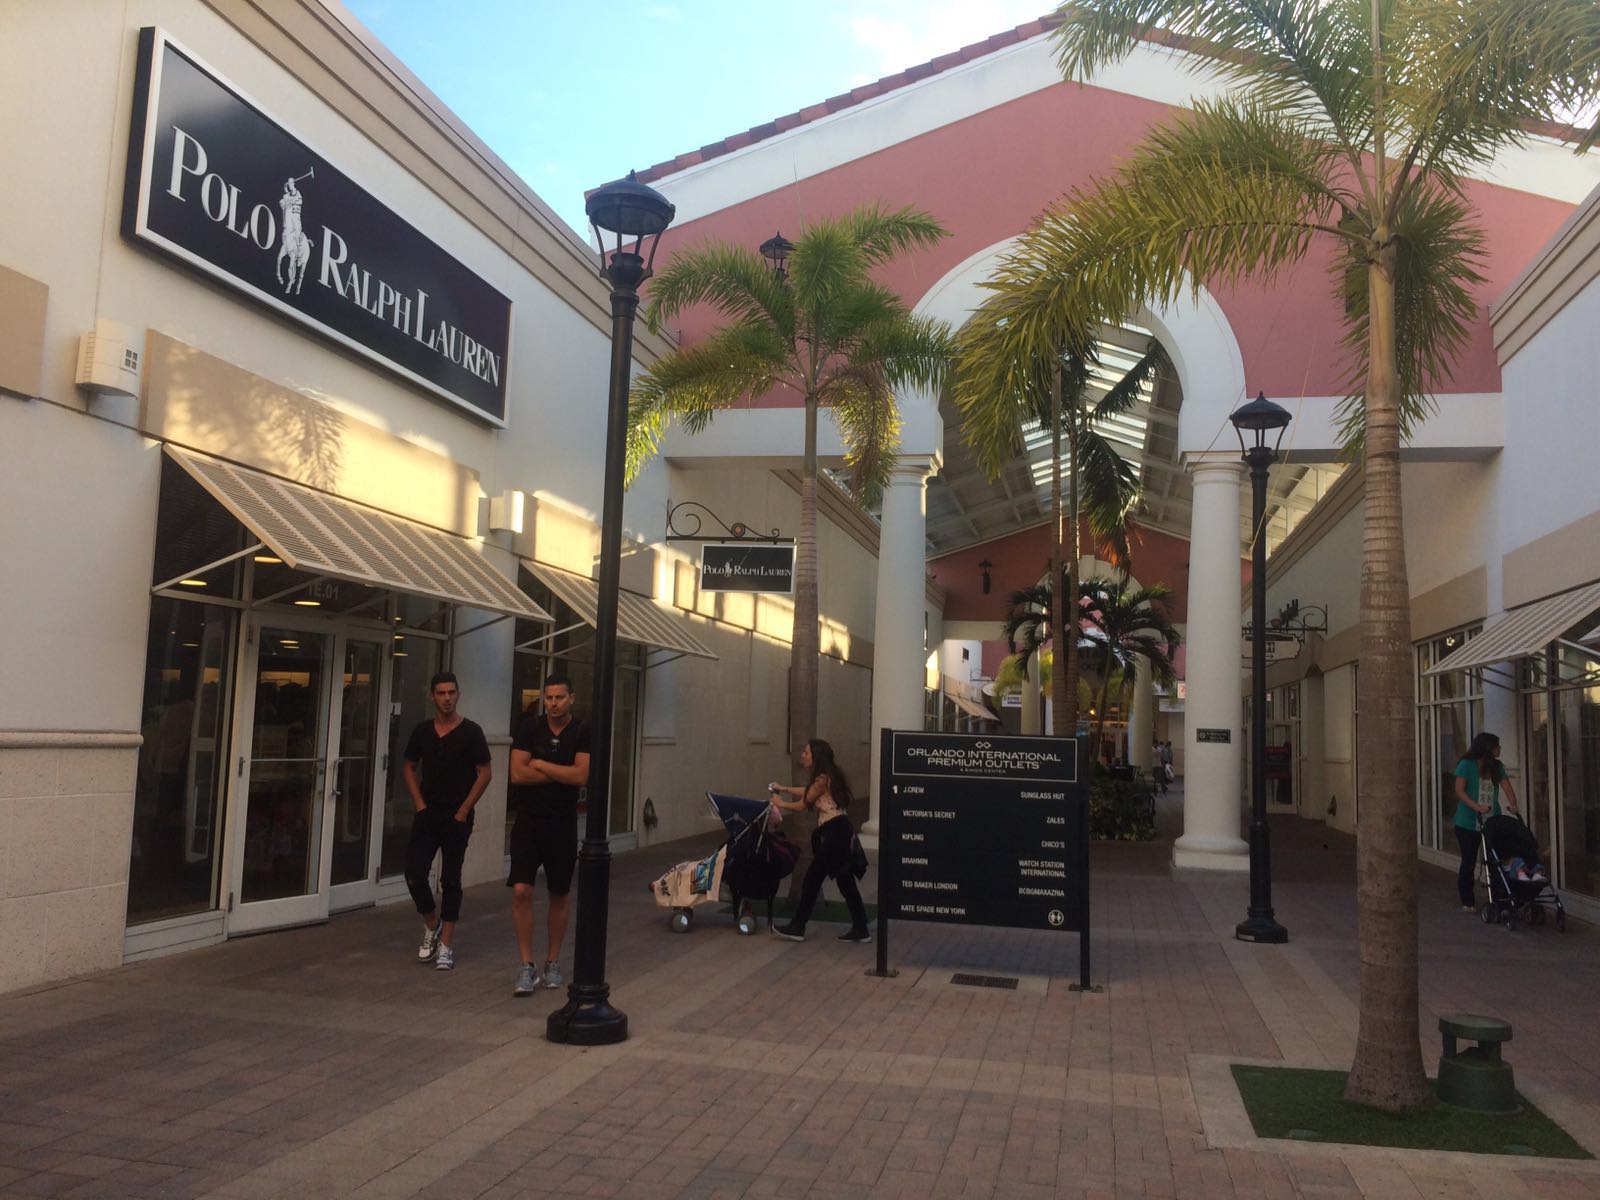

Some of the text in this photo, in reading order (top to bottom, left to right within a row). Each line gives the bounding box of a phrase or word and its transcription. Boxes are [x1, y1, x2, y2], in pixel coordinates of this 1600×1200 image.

[166, 125, 502, 388] POLO RALPH LAUREN
[703, 564, 792, 576] POLO RALPH LAUREN
[907, 747, 1061, 762] ORLANDO INTERNATIONAL
[927, 757, 1040, 770] PREMIUM OUTLETS
[892, 785, 898, 794] 1
[903, 785, 925, 794] J.CREW
[1020, 791, 1065, 800] SUNGLASS HUT
[902, 810, 956, 820] VICTORIA'S SECRET
[1046, 816, 1065, 825] ZALES
[902, 833, 924, 841] KIPLING
[1041, 840, 1065, 849] CHICO'S
[901, 857, 928, 865] BRAHMIN
[1018, 860, 1065, 869] WATCH STATION
[1021, 868, 1066, 878] INTERNATIONAL
[902, 880, 958, 890] TED BAKER LONDON
[1018, 887, 1065, 897] BCBGMAXAZRIA
[901, 904, 966, 915] KATE SPADE NEW YORK
